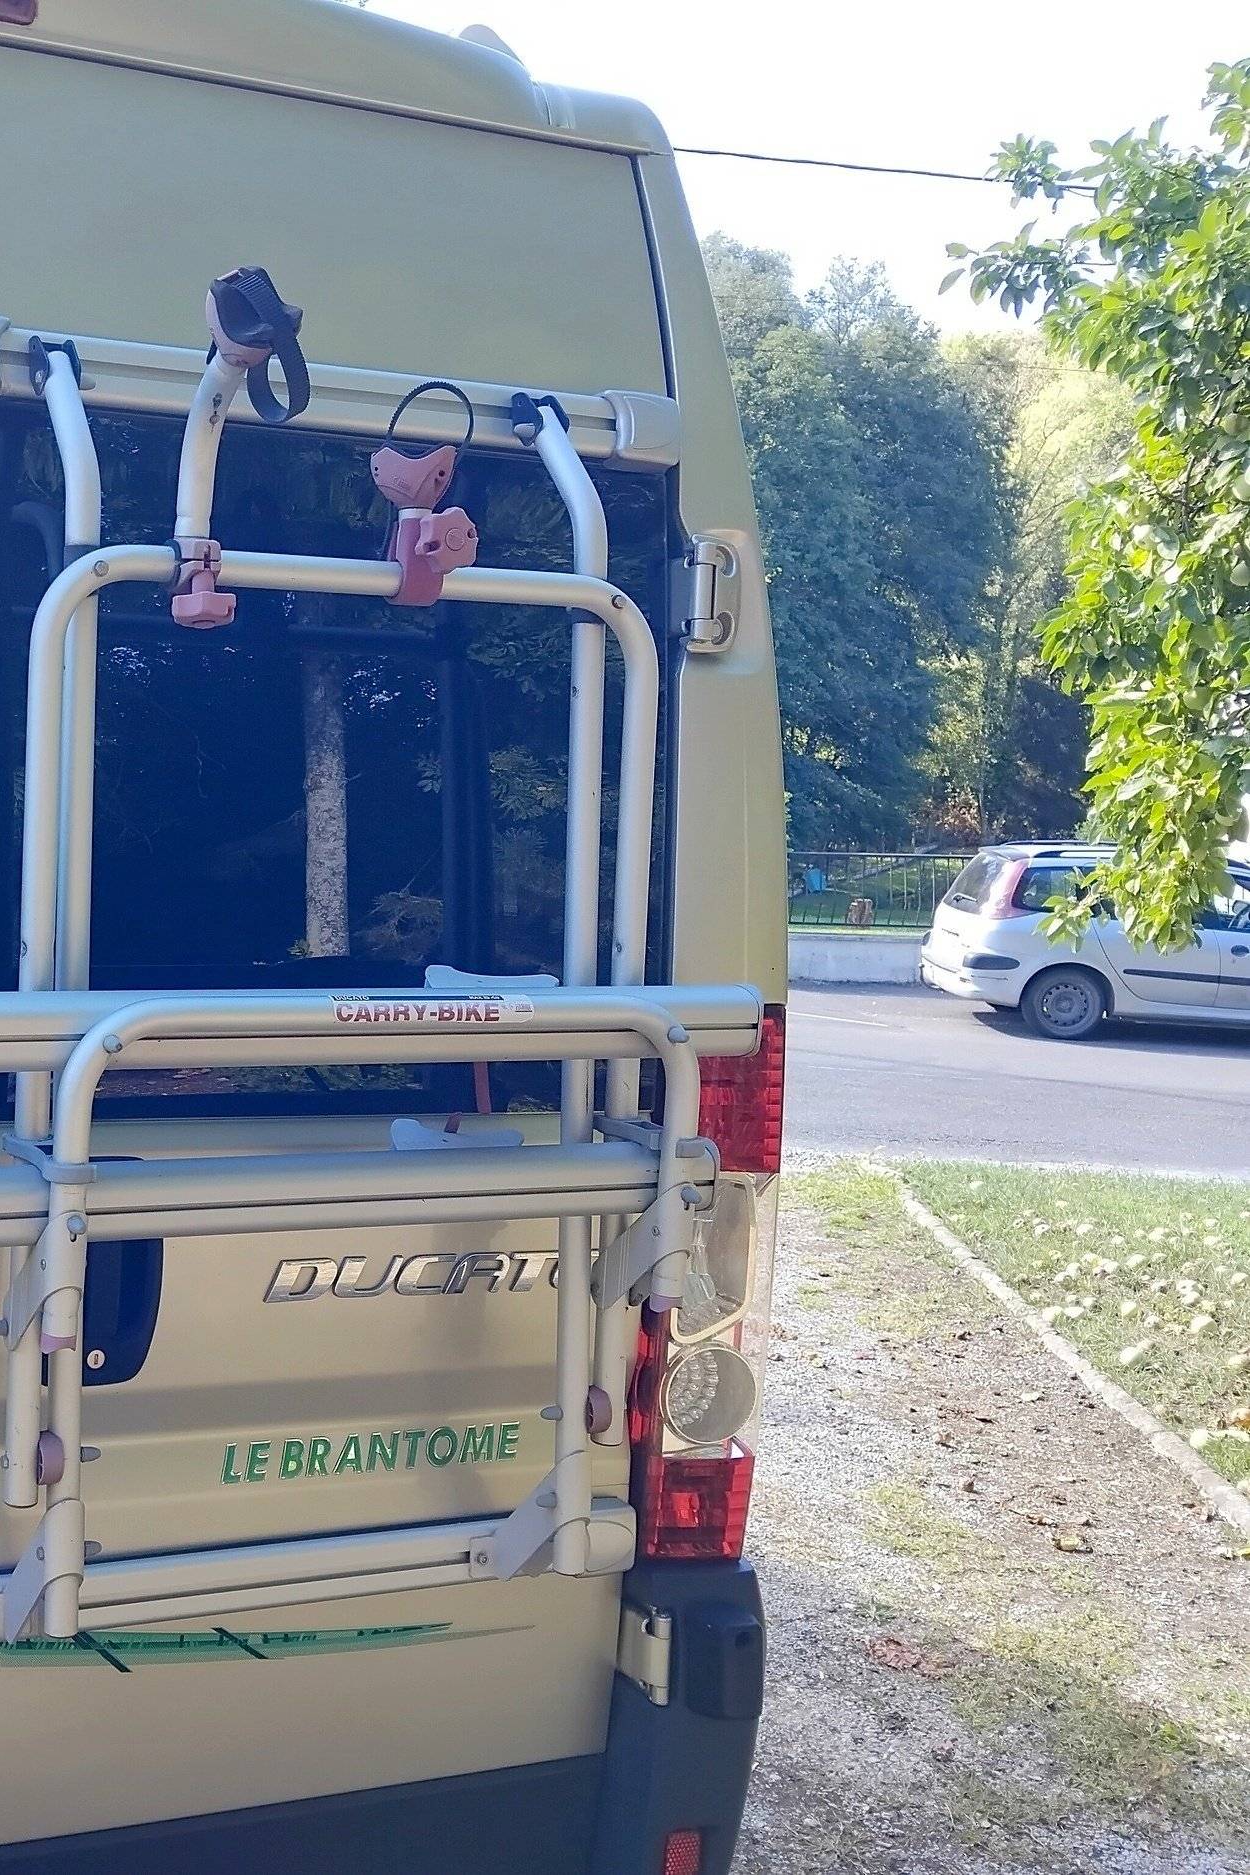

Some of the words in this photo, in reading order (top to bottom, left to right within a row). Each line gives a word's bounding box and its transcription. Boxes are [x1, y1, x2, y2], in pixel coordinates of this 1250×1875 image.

[336, 1003, 500, 1022] CARRY-BIKE
[263, 1249, 599, 1304] DUCAT
[220, 1440, 271, 1486] LE
[279, 1421, 520, 1480] BRANTOME
